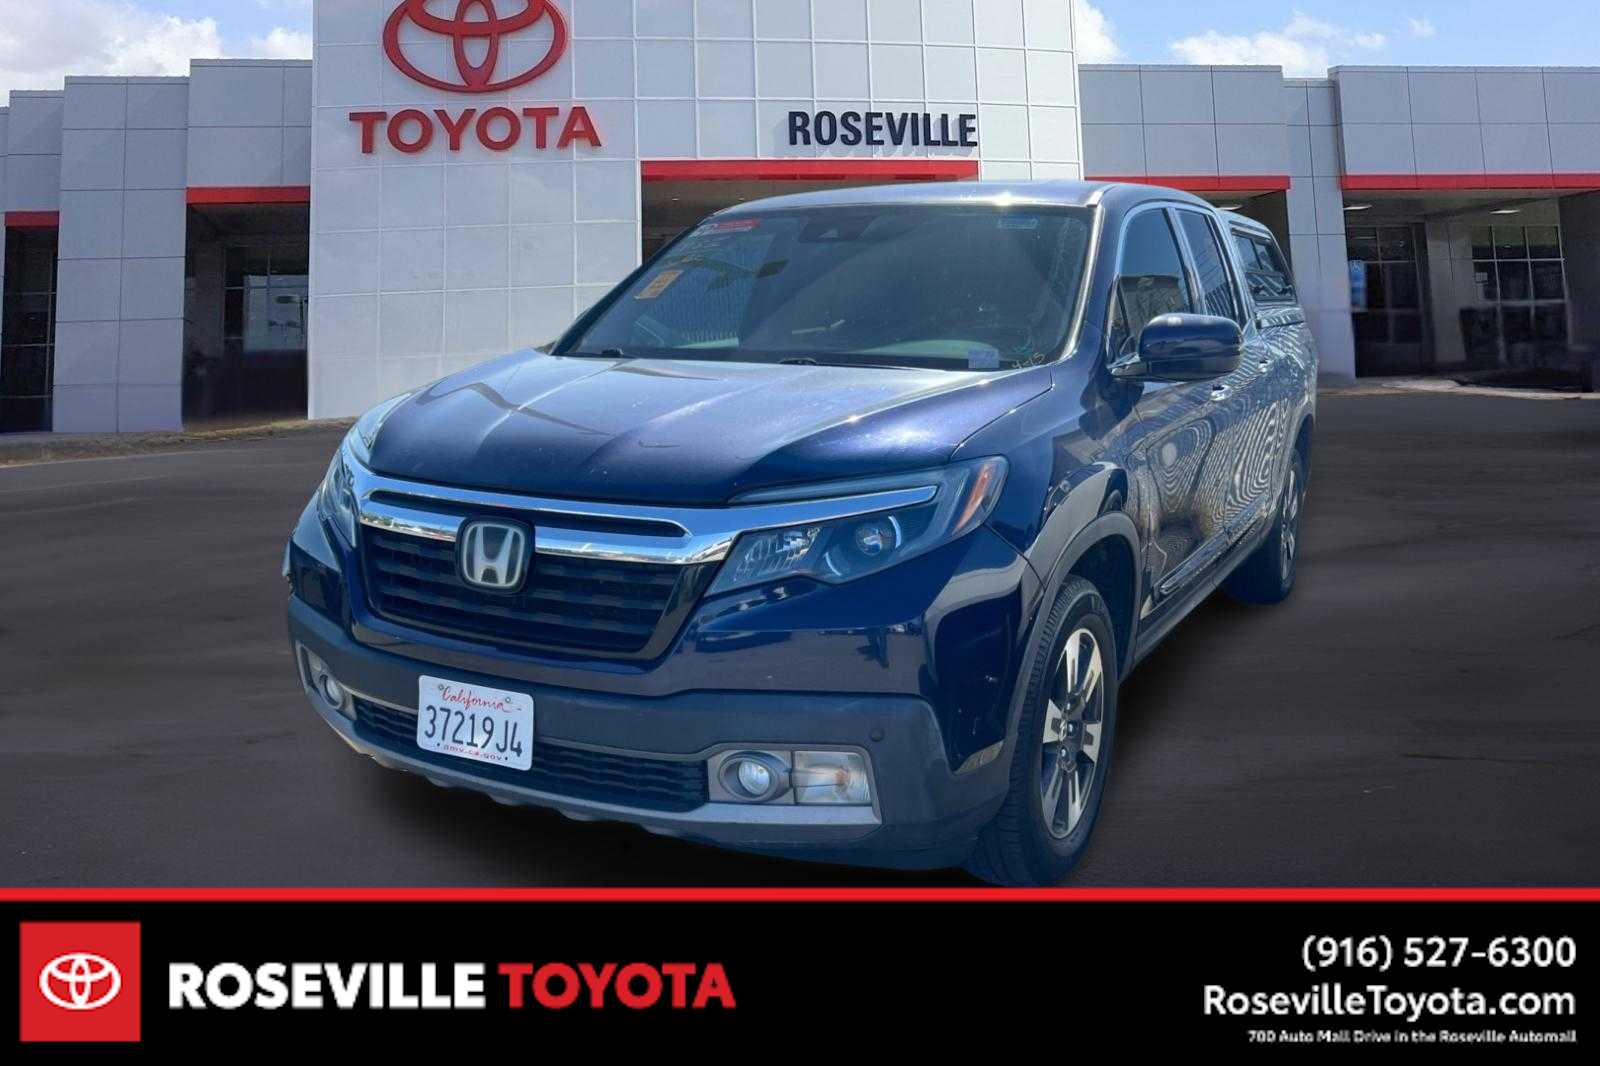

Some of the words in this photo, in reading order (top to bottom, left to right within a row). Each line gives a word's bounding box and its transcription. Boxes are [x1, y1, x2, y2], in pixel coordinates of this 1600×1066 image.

[349, 106, 602, 154] TOYOTA
[788, 111, 978, 147] ROSEVILLE
[442, 685, 511, 713] California
[424, 704, 523, 758] 37219J4
